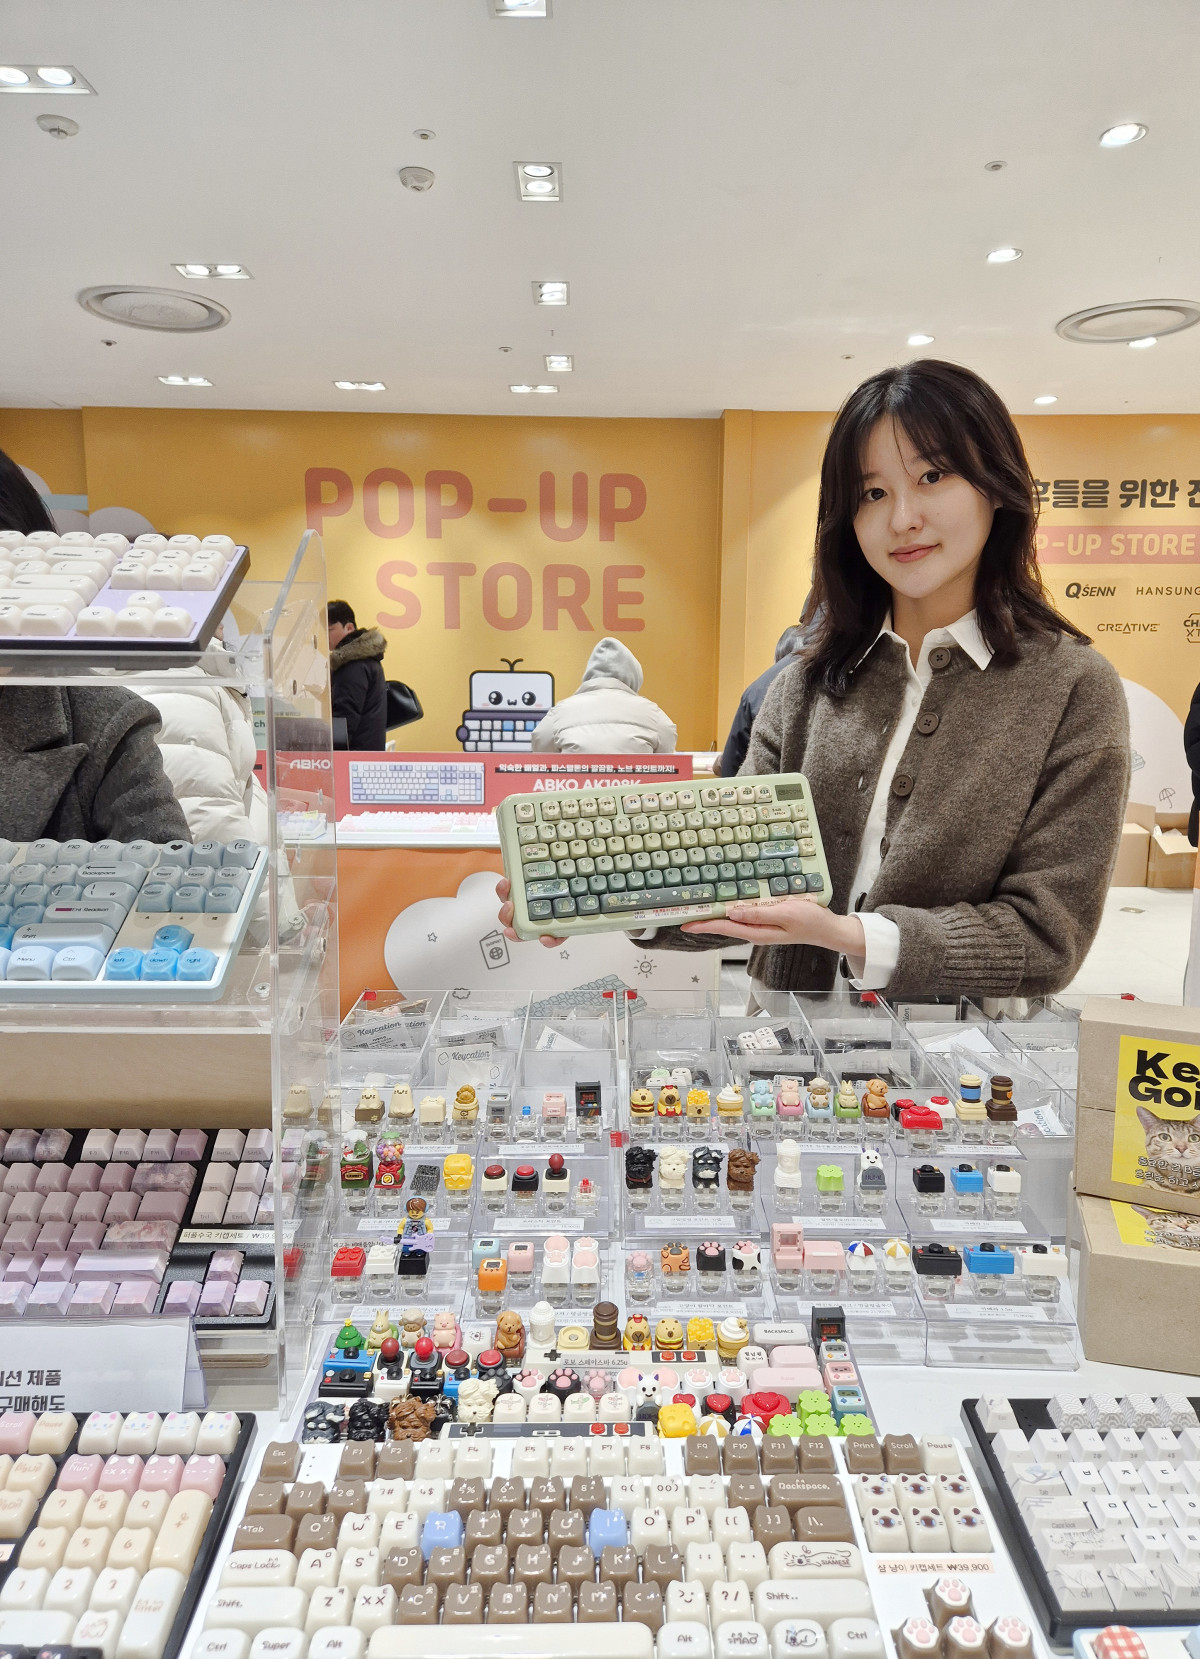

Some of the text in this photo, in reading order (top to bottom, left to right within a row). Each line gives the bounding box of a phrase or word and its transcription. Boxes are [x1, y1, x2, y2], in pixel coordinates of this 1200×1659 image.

[1119, 478, 1180, 508] 위한
[304, 467, 647, 542] POP-UP
[1110, 533, 1196, 556] STORE
[376, 560, 645, 632] STORE
[1097, 622, 1160, 634] CREATIVE
[289, 759, 331, 770] ABKO
[357, 1020, 402, 1037] Keycation
[451, 1049, 491, 1062] Keycation
[563, 1358, 576, 1366] 로보
[578, 1358, 610, 1366] 스페이스바
[26, 1369, 61, 1387] 제품
[601, 1444, 613, 1452] F7
[853, 1441, 875, 1449] Print
[890, 1441, 914, 1449] Scroll
[927, 1441, 953, 1449] Pause
[272, 1449, 287, 1457] Esc
[351, 1448, 363, 1456] F1
[390, 1447, 402, 1455] F2
[395, 1520, 405, 1530] E
[435, 1520, 447, 1530] R
[519, 1517, 530, 1528] Y
[686, 1516, 696, 1525] P
[247, 1525, 264, 1533] Tab
[310, 1522, 321, 1533] Q
[351, 1522, 365, 1531] W
[310, 1559, 322, 1569] A
[355, 1557, 365, 1567] S
[397, 1556, 408, 1567] D
[440, 1555, 452, 1566] F
[485, 1555, 496, 1565] G
[526, 1554, 539, 1565] H
[613, 1554, 623, 1565] K
[230, 1561, 252, 1571] Caps
[889, 1563, 908, 1573] 냥이
[909, 1563, 944, 1573] 키캡세트
[947, 1563, 989, 1572] ₩39,900
[63, 1579, 73, 1590] 2
[324, 1596, 334, 1606] Z
[457, 1594, 470, 1605] V
[502, 1592, 514, 1603] B
[547, 1593, 559, 1603] N
[591, 1592, 607, 1603] M
[677, 1633, 693, 1644] Alt
[847, 1630, 868, 1640] Ctrl
[207, 1641, 227, 1652] Ctrl
[262, 1641, 292, 1651] Super
[326, 1639, 342, 1649] Alt
